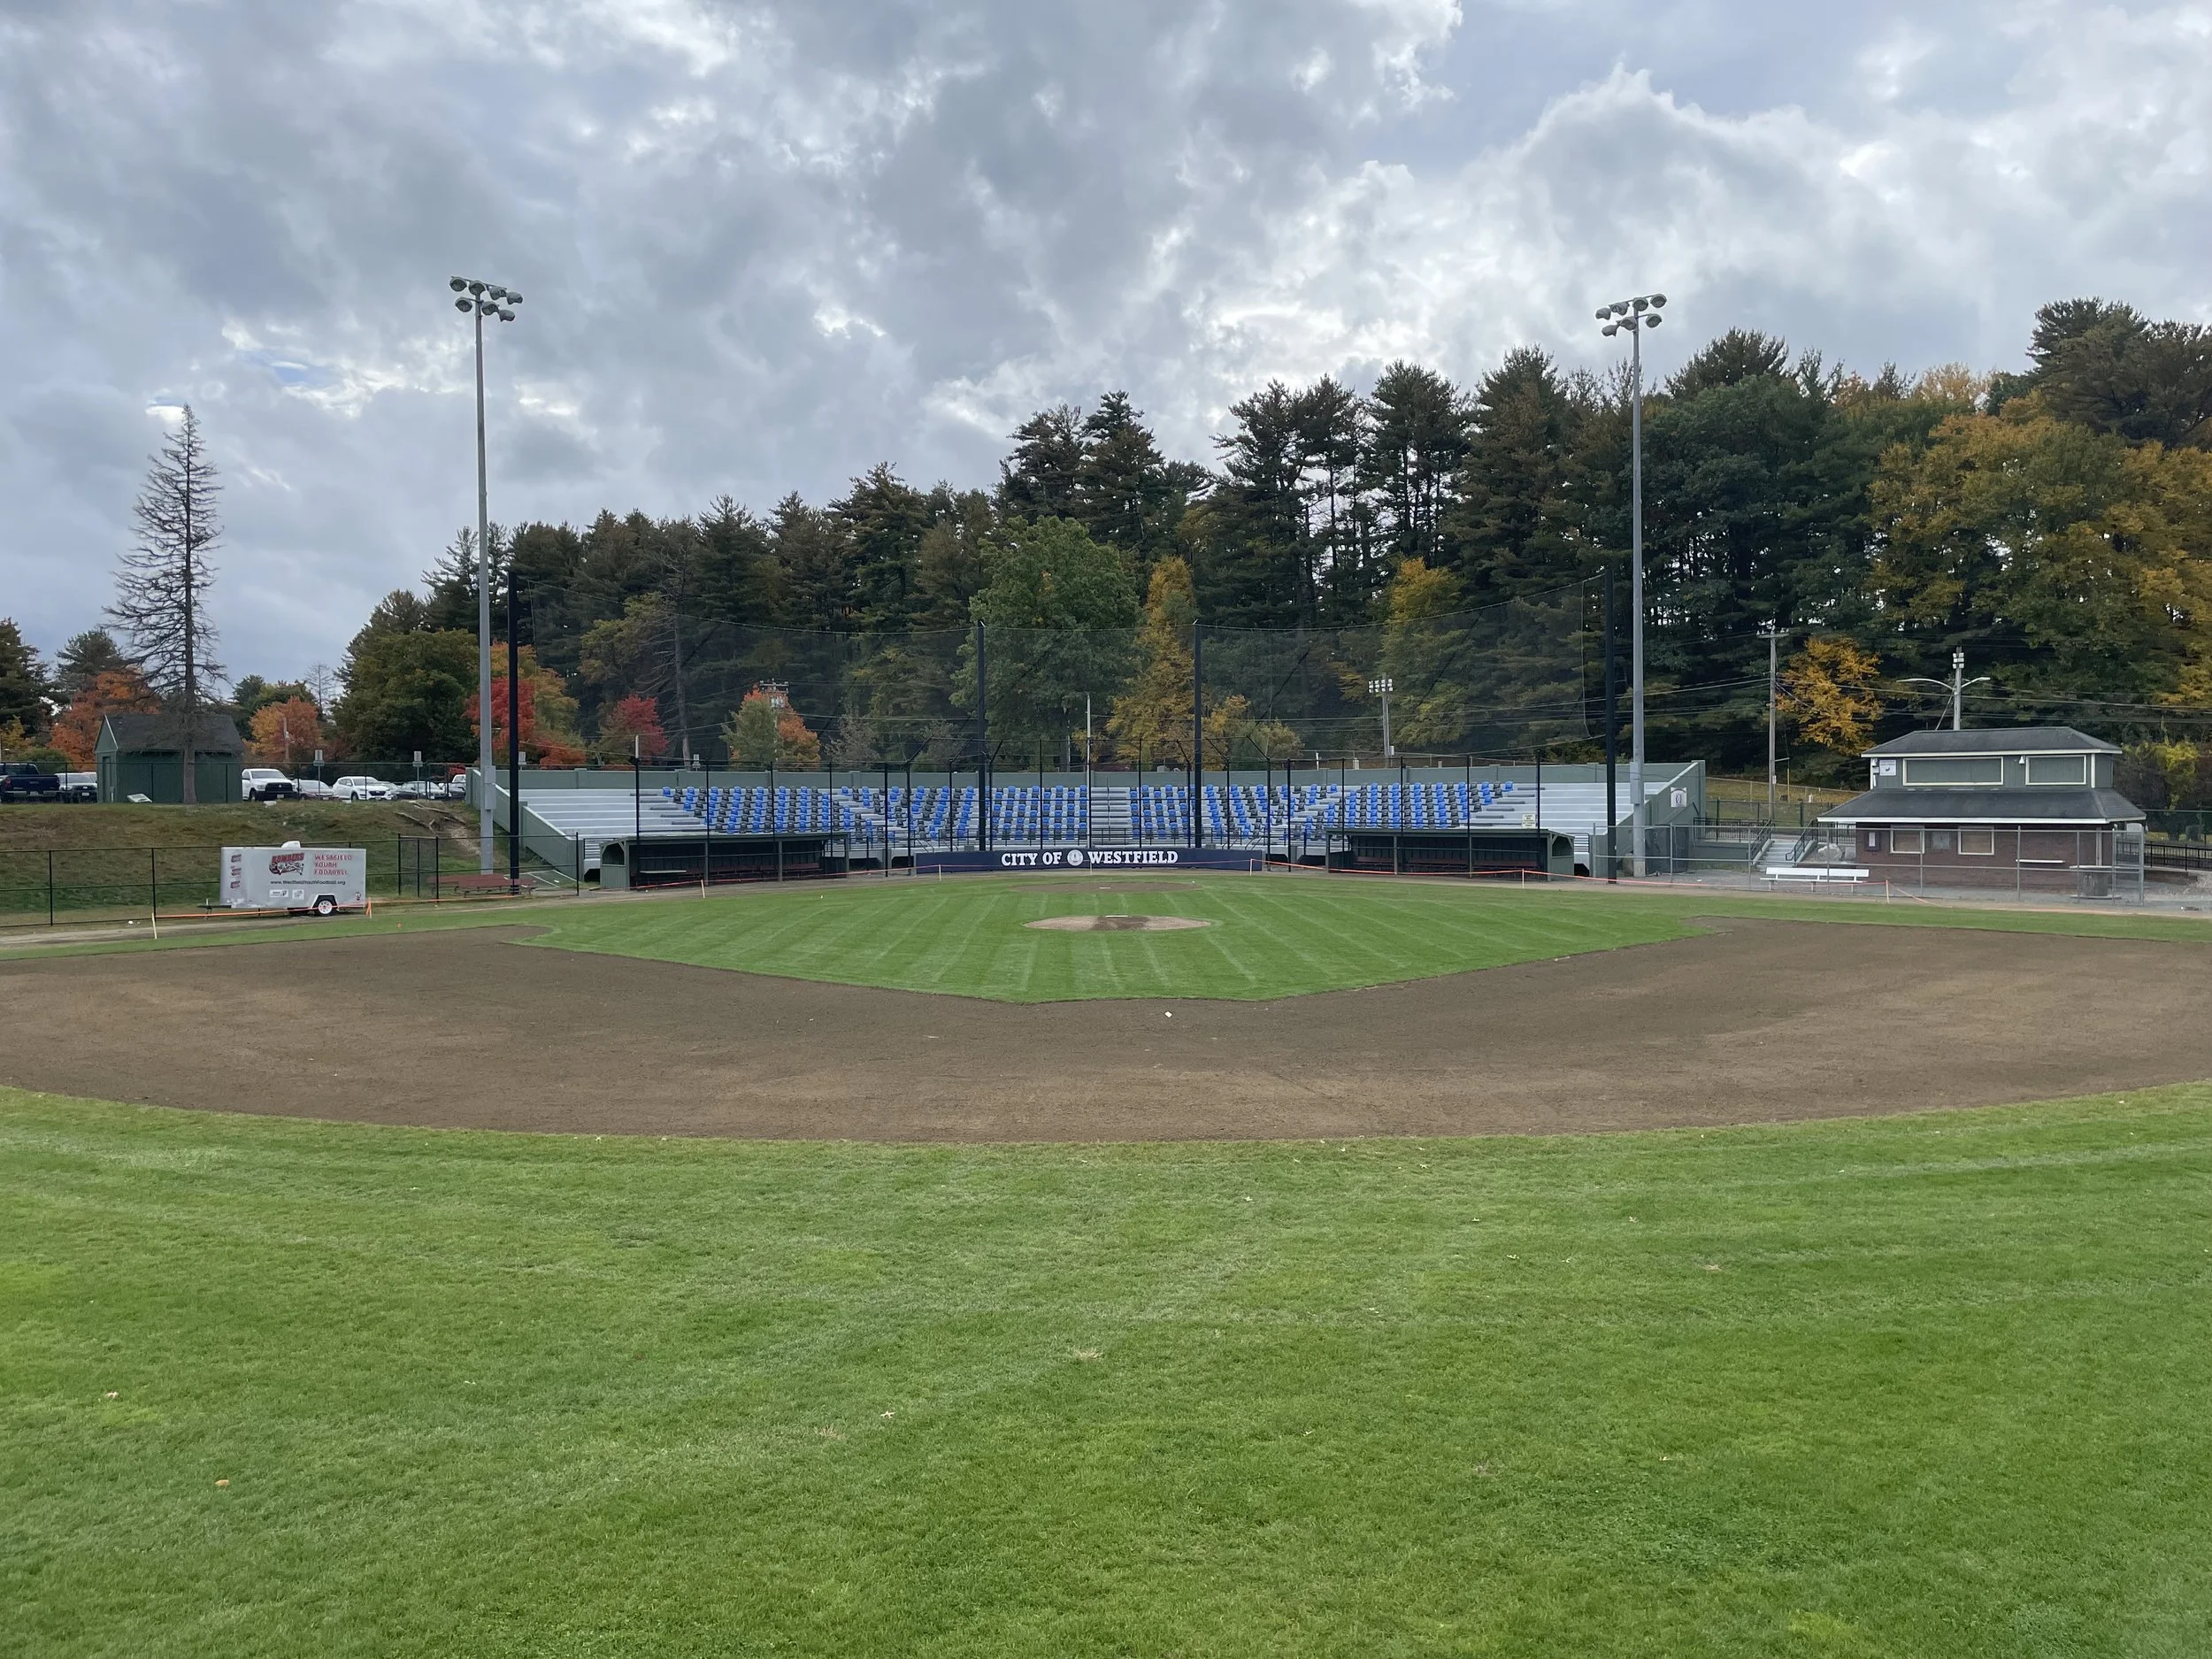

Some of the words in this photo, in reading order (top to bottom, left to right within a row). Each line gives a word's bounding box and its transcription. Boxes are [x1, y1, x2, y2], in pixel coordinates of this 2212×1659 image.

[1001, 852, 1038, 866] CITY
[1042, 851, 1063, 865] OF
[1087, 850, 1179, 864] WESTFIELD
